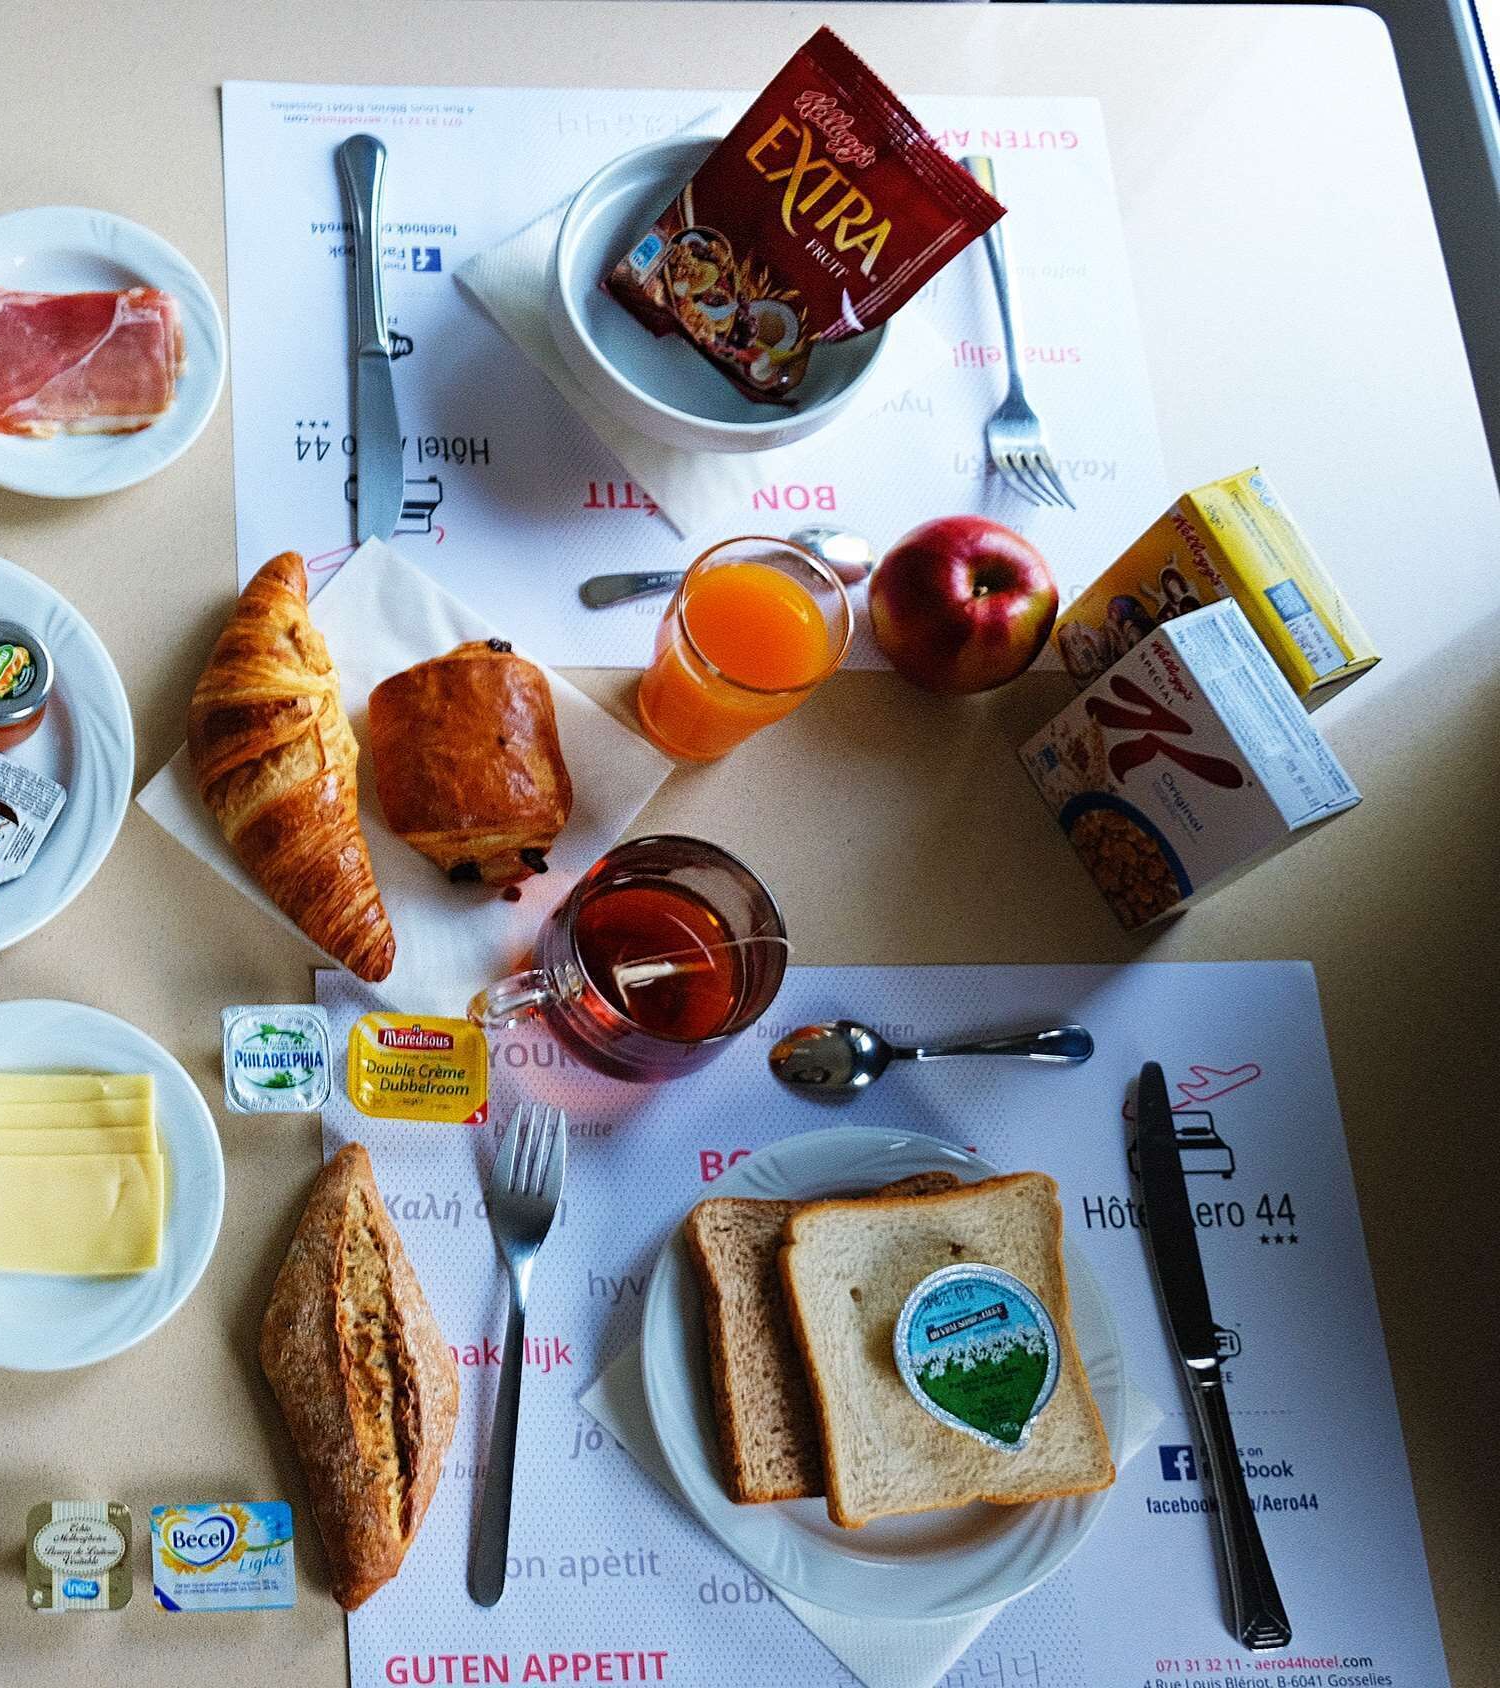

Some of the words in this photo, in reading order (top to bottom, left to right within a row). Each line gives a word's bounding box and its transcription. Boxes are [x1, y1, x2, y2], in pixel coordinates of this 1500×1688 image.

[793, 89, 876, 169] Kellogg's
[981, 129, 1079, 149] GUTEN
[745, 113, 893, 279] EXTRA
[804, 237, 850, 280] FRUIT
[295, 436, 332, 462] 44
[417, 437, 490, 466] Hôtel
[751, 485, 838, 512] BON
[1138, 650, 1175, 708] SPECIAL
[1161, 771, 1205, 835] Original
[382, 1029, 451, 1048] Maredsous
[234, 1048, 324, 1069] PHILADELPHIA
[365, 1059, 416, 1077] Double
[418, 1061, 466, 1080] Crème
[379, 1077, 470, 1097] Dubbelroom
[1192, 1200, 1246, 1228] ero
[1255, 1192, 1297, 1227] 44
[172, 1528, 226, 1550] Becel
[237, 1549, 286, 1576] Light
[384, 1653, 510, 1684] GUTEN
[520, 1650, 669, 1683] APPETIT
[1156, 1659, 1181, 1674] 071
[1185, 1658, 1202, 1673] 31
[1206, 1657, 1223, 1672] 32
[1226, 1657, 1241, 1671] 11
[1254, 1655, 1374, 1671] aero44hotel.com
[1185, 1676, 1221, 1688] Louis
[1277, 1674, 1324, 1688] B-6041
[1328, 1673, 1393, 1687] Gosselies
